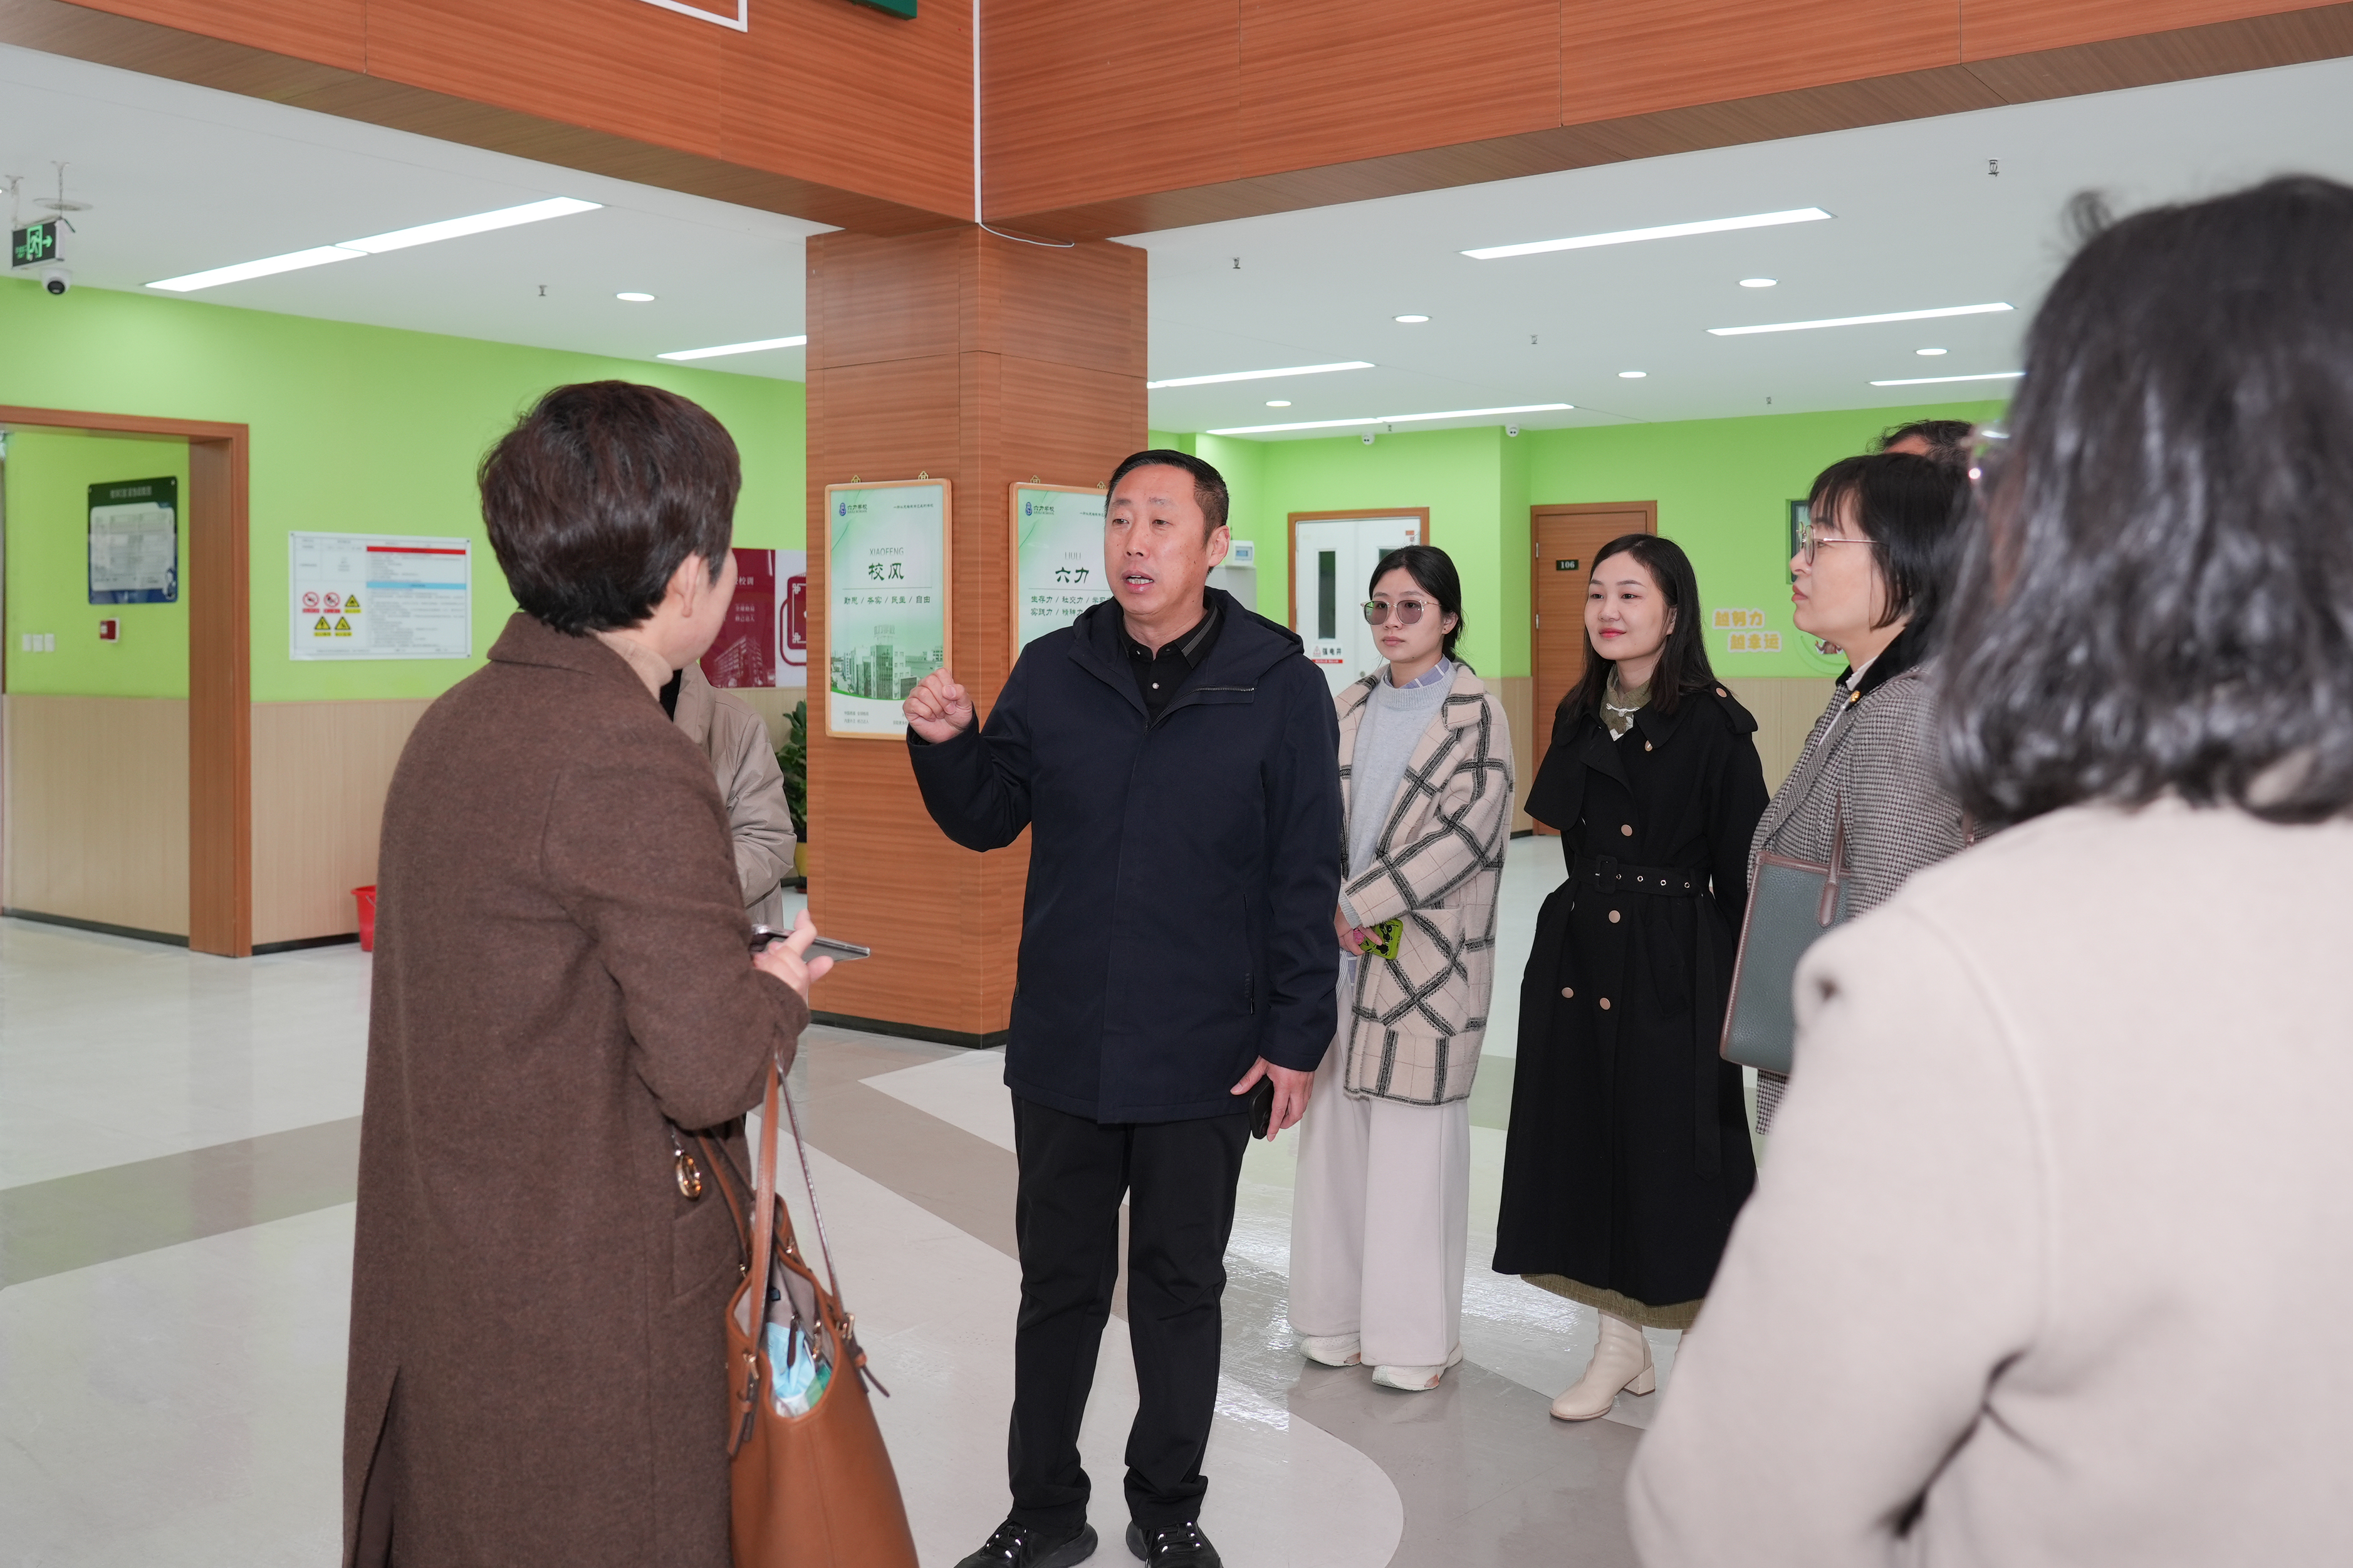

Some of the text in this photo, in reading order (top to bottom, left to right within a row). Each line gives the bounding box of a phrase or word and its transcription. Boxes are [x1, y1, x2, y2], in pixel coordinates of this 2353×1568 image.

[870, 547, 904, 556] XIAOFENG
[1065, 552, 1082, 560] LIULI
[1560, 561, 1575, 569] 106
[869, 563, 905, 581] 校风
[1055, 567, 1089, 584] 六力
[916, 595, 931, 604] 自由
[1031, 595, 1053, 604] 生存力
[1062, 596, 1083, 605] 社交力
[1030, 608, 1053, 616] 实践力
[1715, 610, 1763, 626] 越努力
[1730, 634, 1780, 650] 越幸运
[1322, 647, 1342, 655] 强电井
